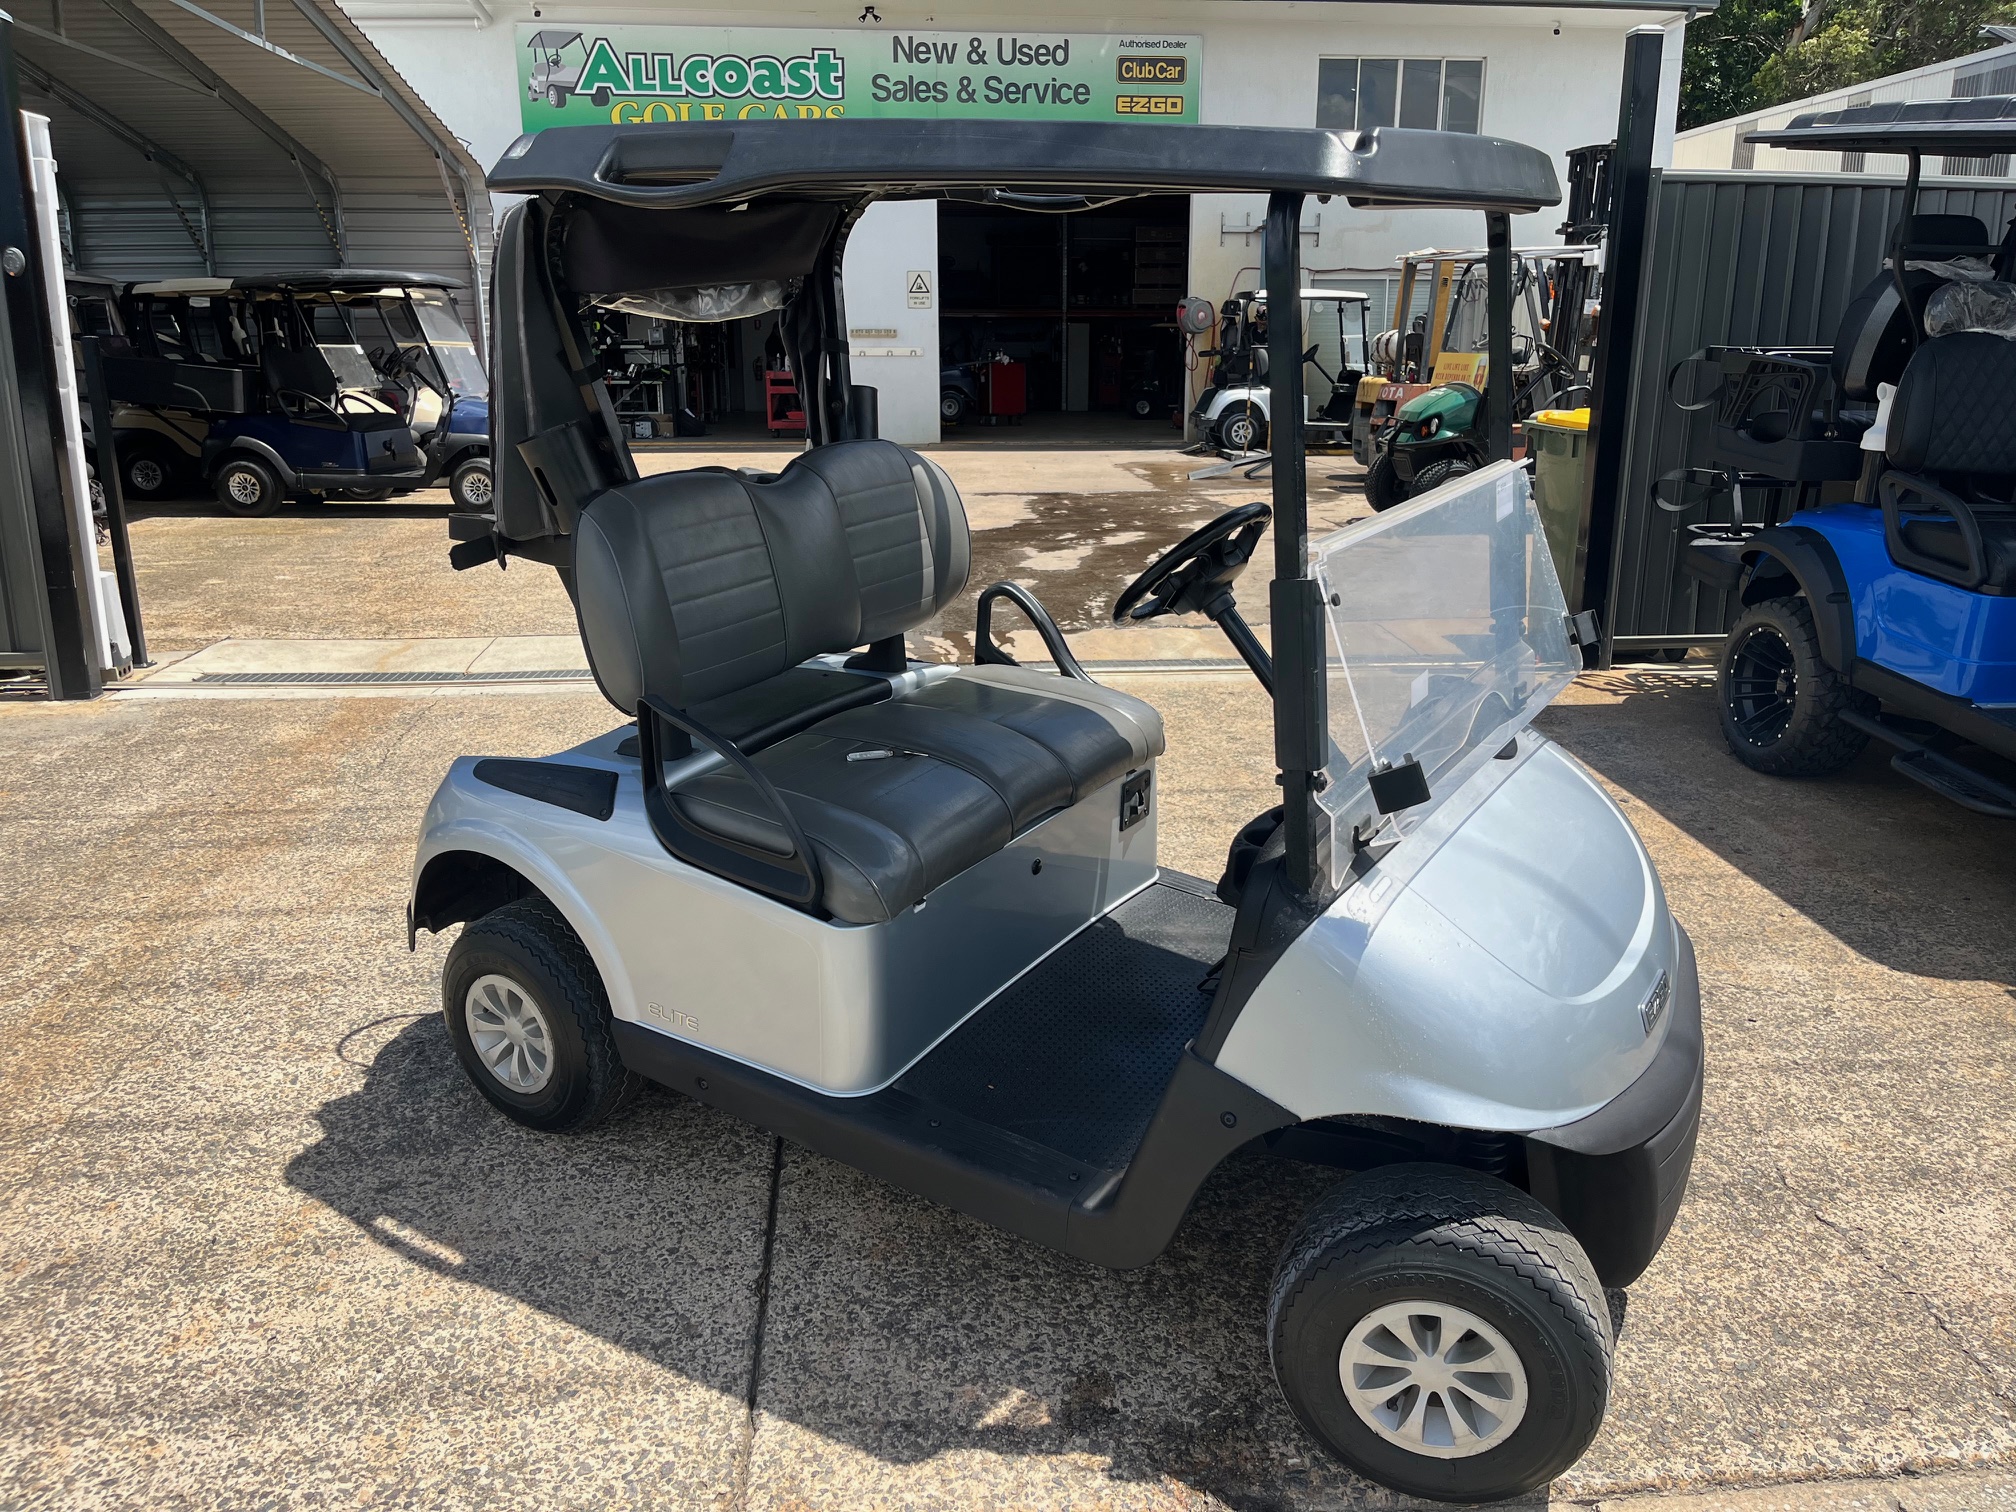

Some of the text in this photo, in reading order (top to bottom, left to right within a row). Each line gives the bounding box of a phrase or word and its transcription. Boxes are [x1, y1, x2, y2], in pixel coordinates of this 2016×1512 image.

[892, 36, 1070, 67] New & Used
[1118, 40, 1187, 49] Authorised Dealer
[871, 73, 1091, 105] Sales & Service
[648, 1001, 699, 1032] ELITE
